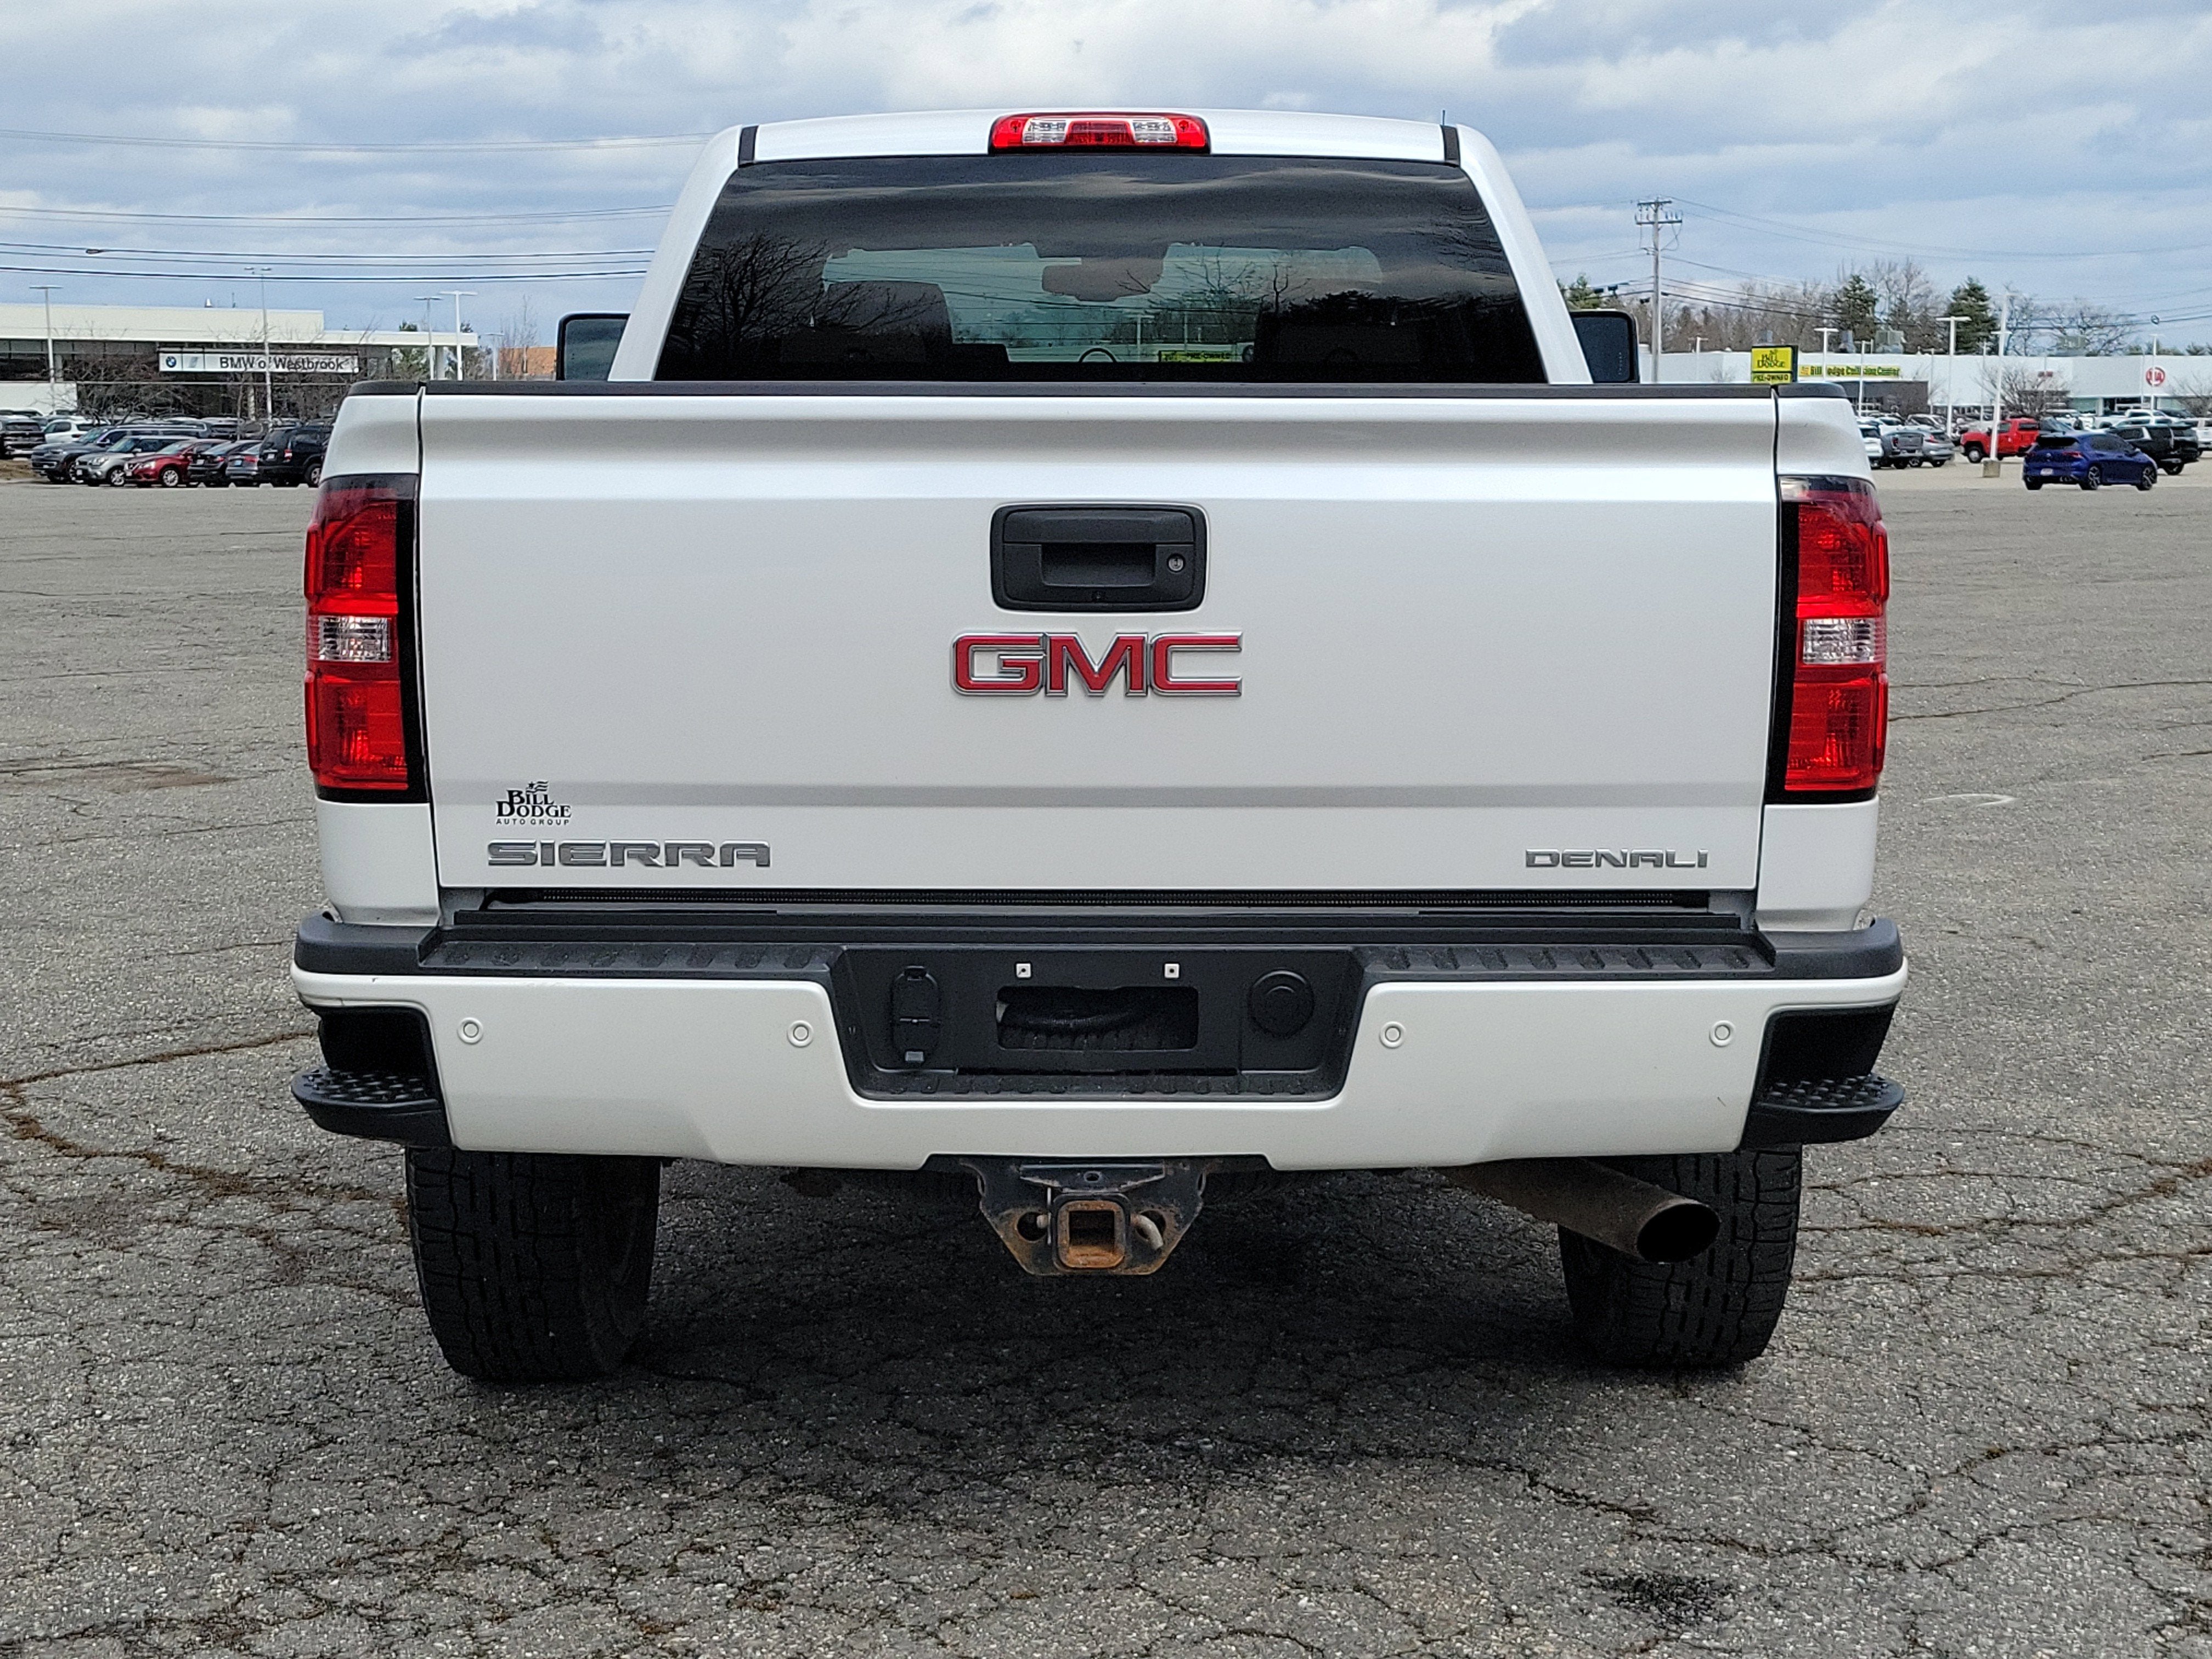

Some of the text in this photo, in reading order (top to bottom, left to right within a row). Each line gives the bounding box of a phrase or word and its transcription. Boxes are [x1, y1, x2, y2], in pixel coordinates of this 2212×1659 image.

[220, 357, 344, 370] BMW o Westbrook
[951, 631, 1243, 696] GMC
[506, 789, 555, 805] BILL
[496, 801, 572, 817] DODGE
[488, 840, 771, 867] SIERRA
[1526, 849, 1708, 868] DENALI
